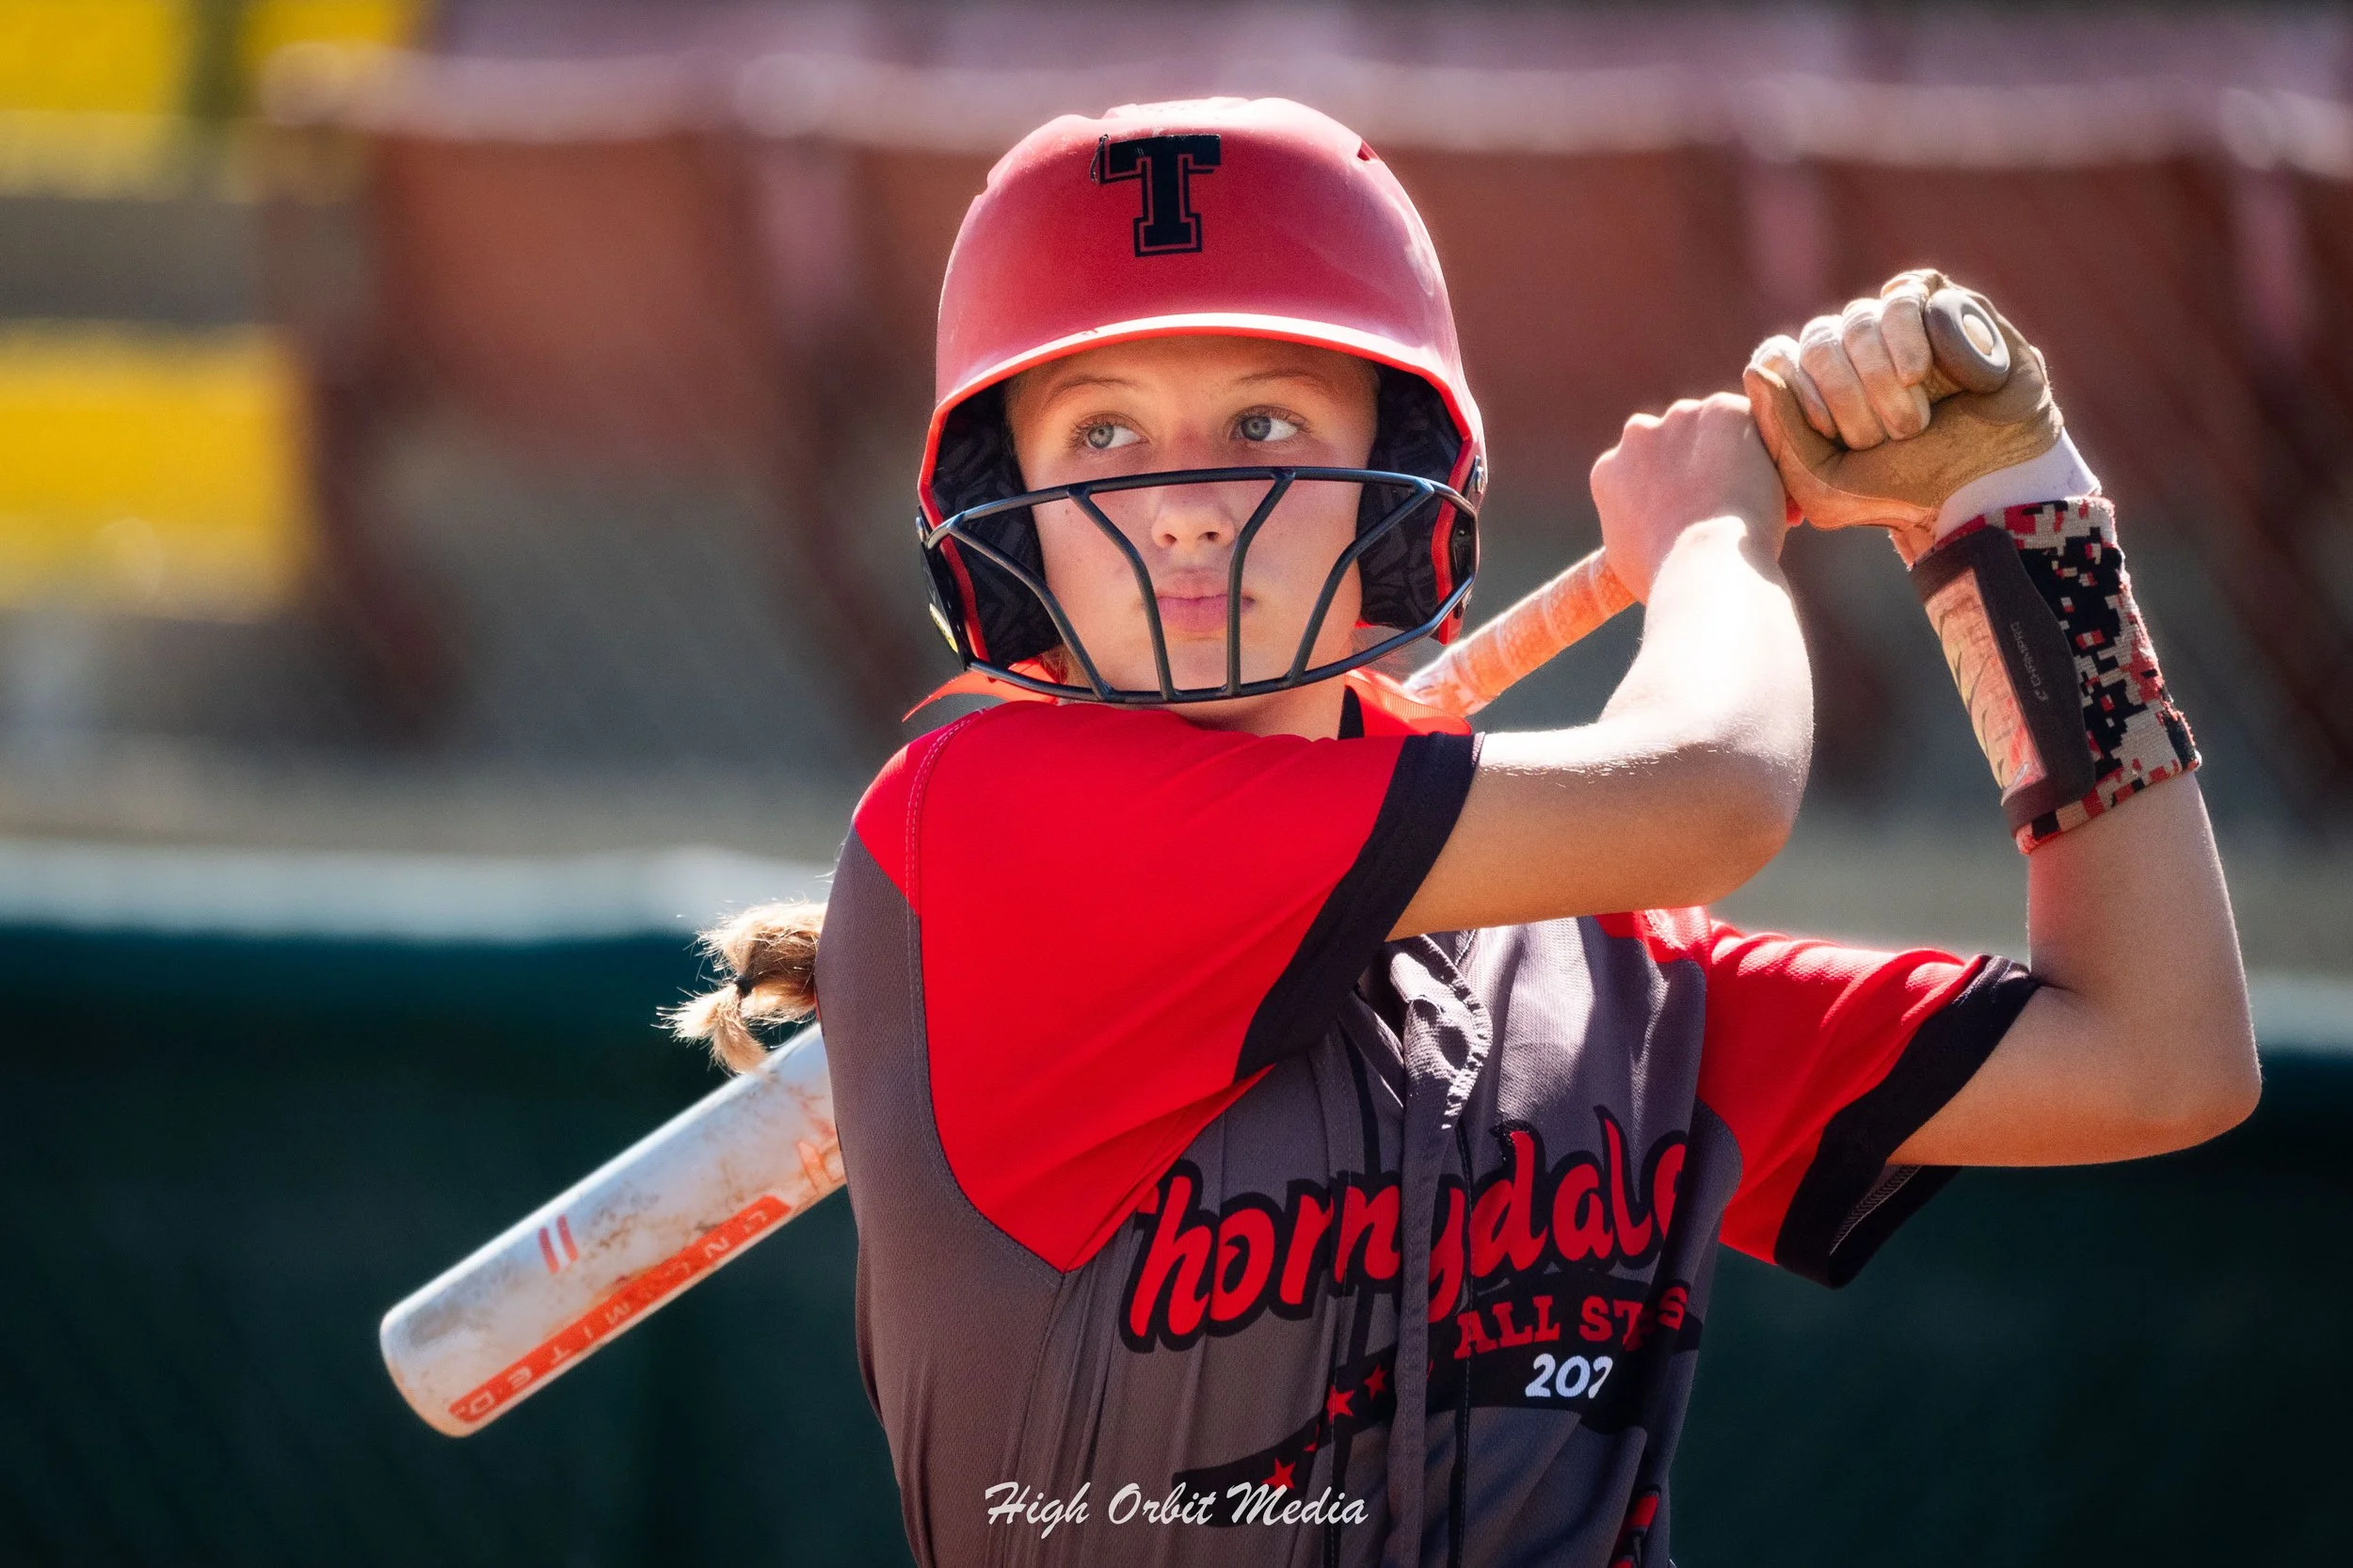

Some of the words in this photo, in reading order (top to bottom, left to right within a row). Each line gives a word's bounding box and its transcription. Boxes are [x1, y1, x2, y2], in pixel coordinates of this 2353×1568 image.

[1098, 134, 1222, 257] T
[1124, 1112, 1688, 1344] hornydal
[470, 1208, 769, 1416] UNLMITED
[1453, 1295, 1560, 1359] ALL
